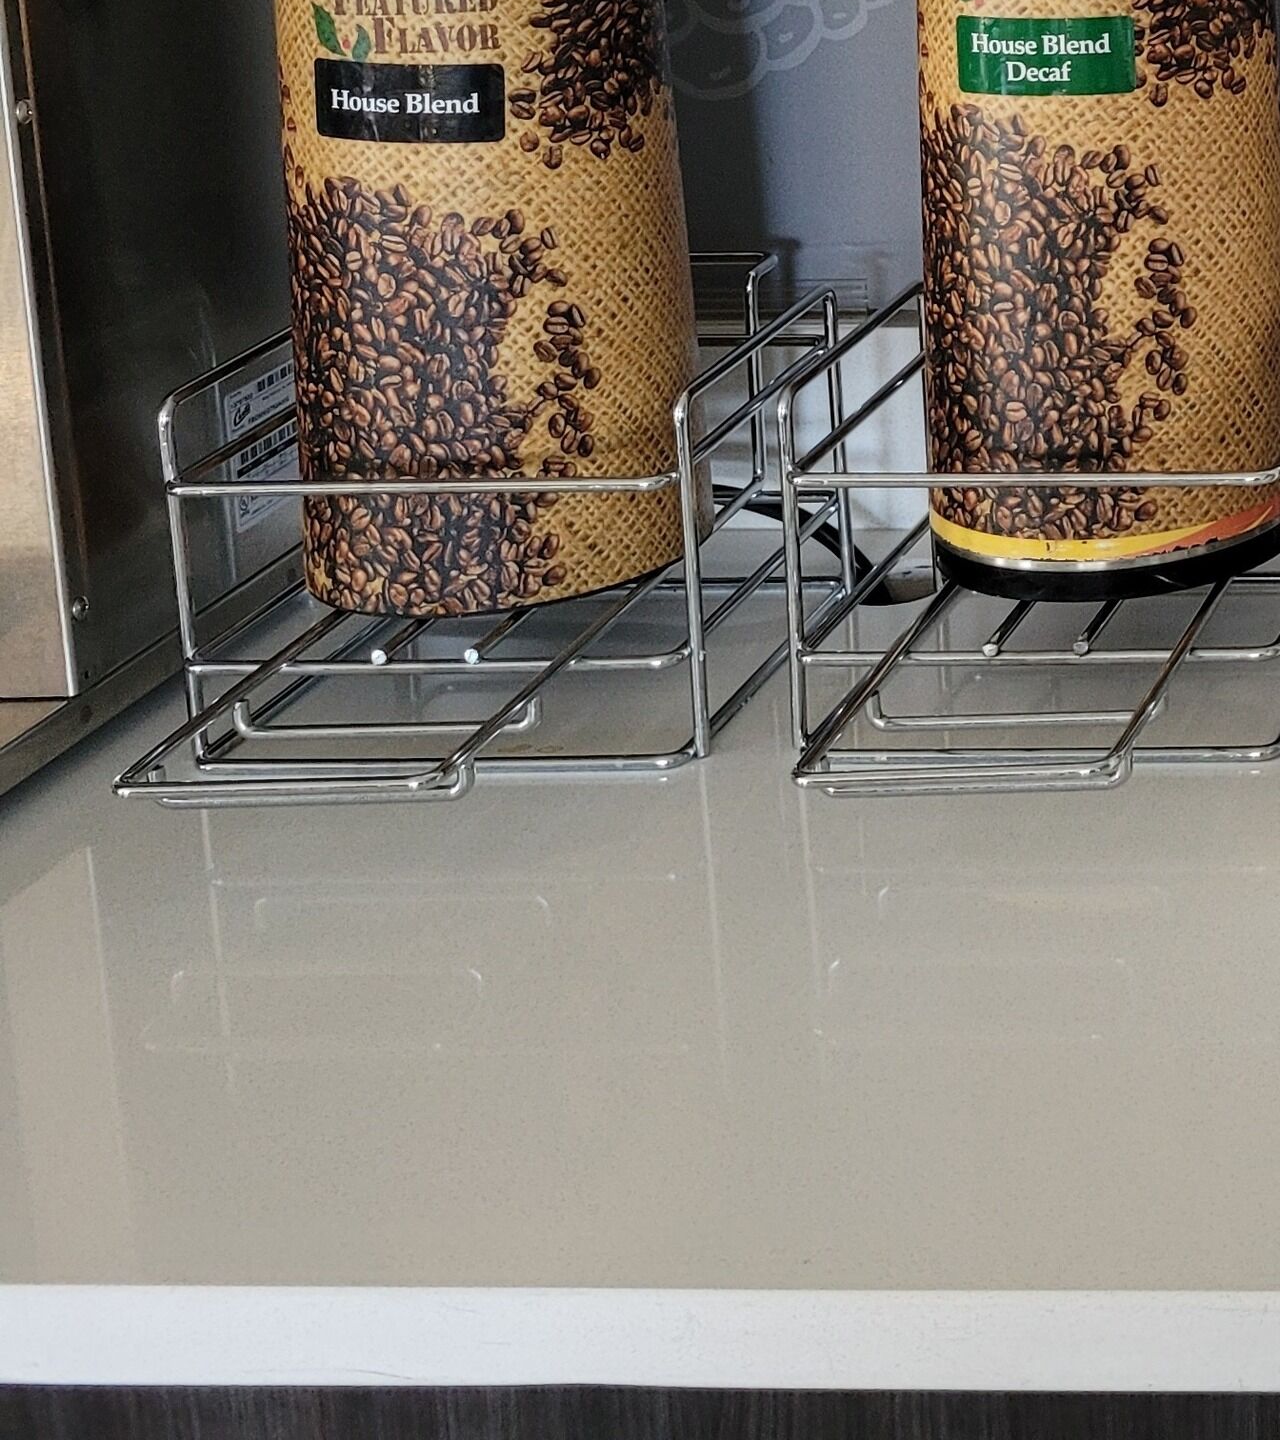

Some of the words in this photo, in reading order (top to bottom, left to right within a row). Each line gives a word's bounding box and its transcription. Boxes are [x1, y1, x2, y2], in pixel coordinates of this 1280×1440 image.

[971, 33, 1038, 56] House
[1041, 34, 1112, 56] Blend
[1007, 61, 1072, 83] Decaf
[330, 88, 400, 114] House
[405, 92, 480, 115] Blend
